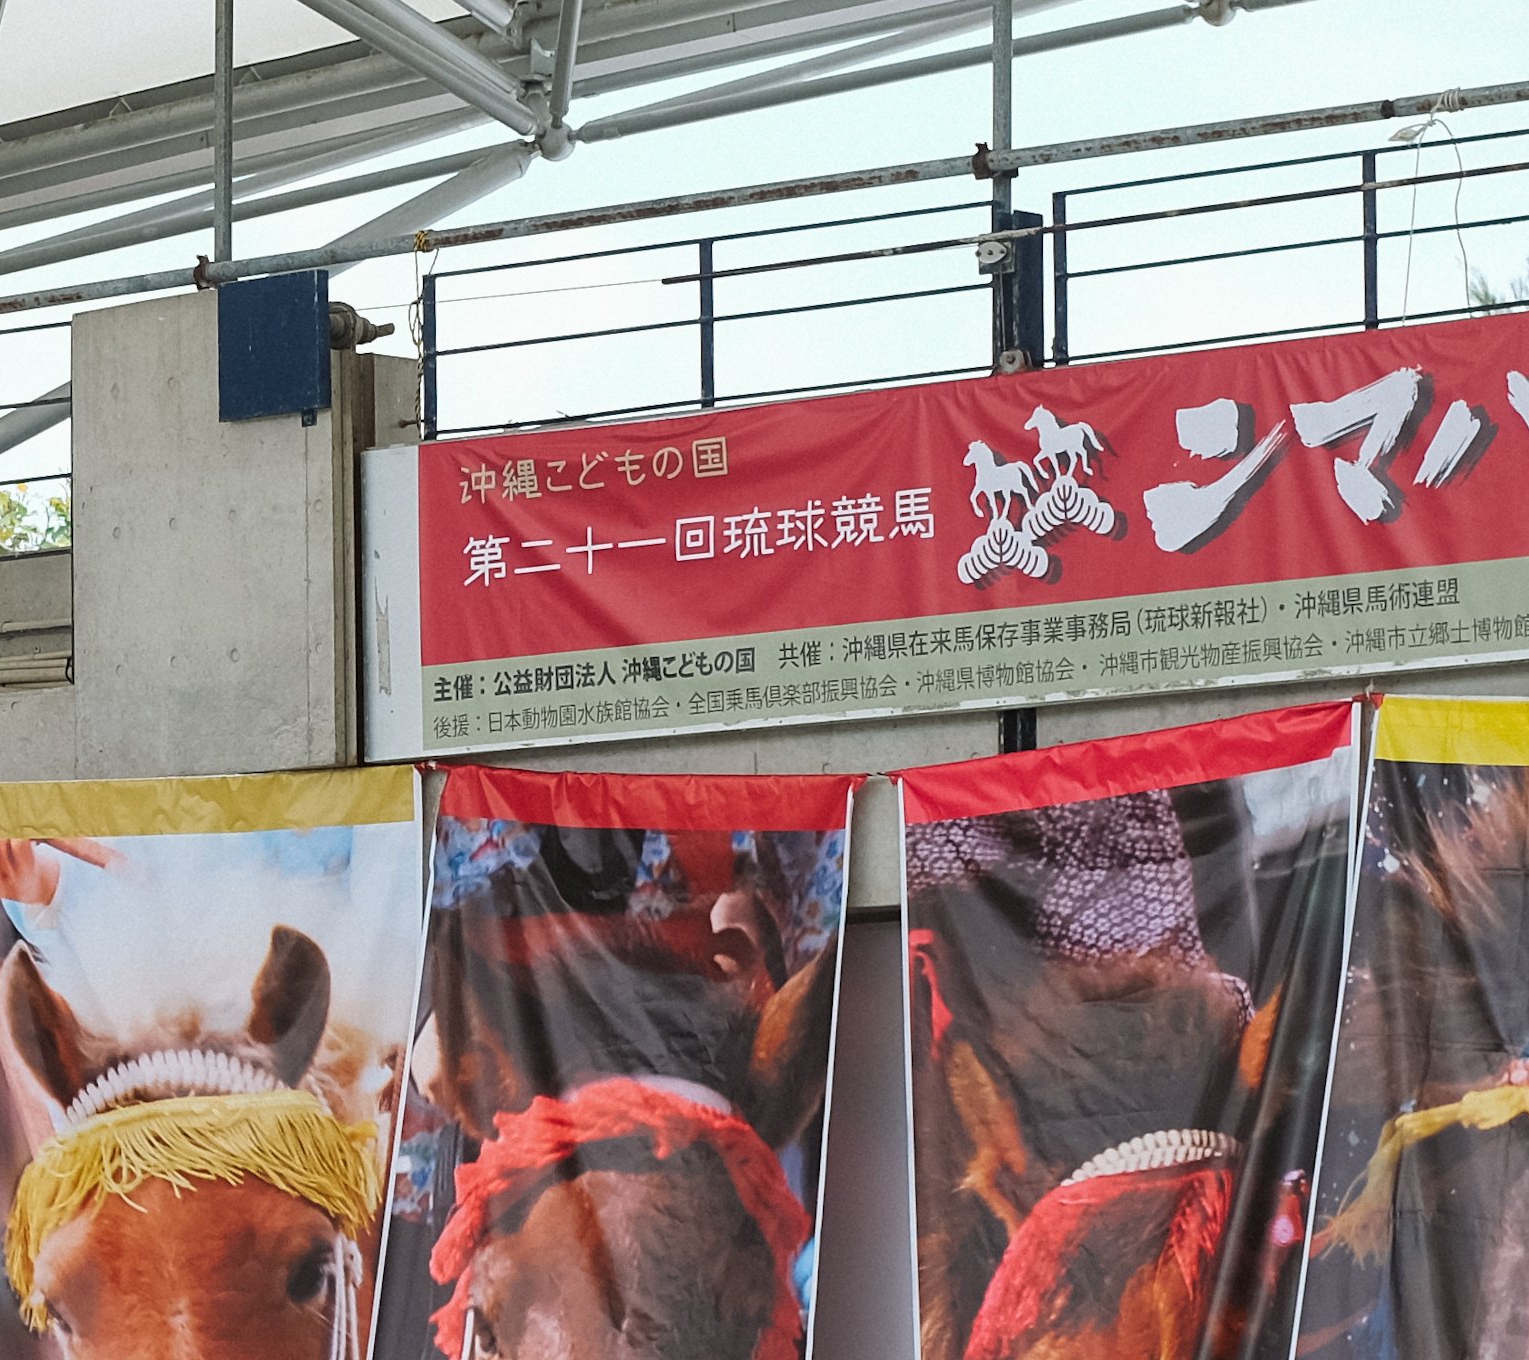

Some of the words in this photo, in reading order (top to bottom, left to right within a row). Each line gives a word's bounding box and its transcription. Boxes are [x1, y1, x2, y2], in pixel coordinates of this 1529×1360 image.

[458, 436, 730, 505] 沖縄こどもの国
[462, 486, 936, 588] 第二十一回琉球競馬
[621, 646, 757, 691] 沖縄こどもの国
